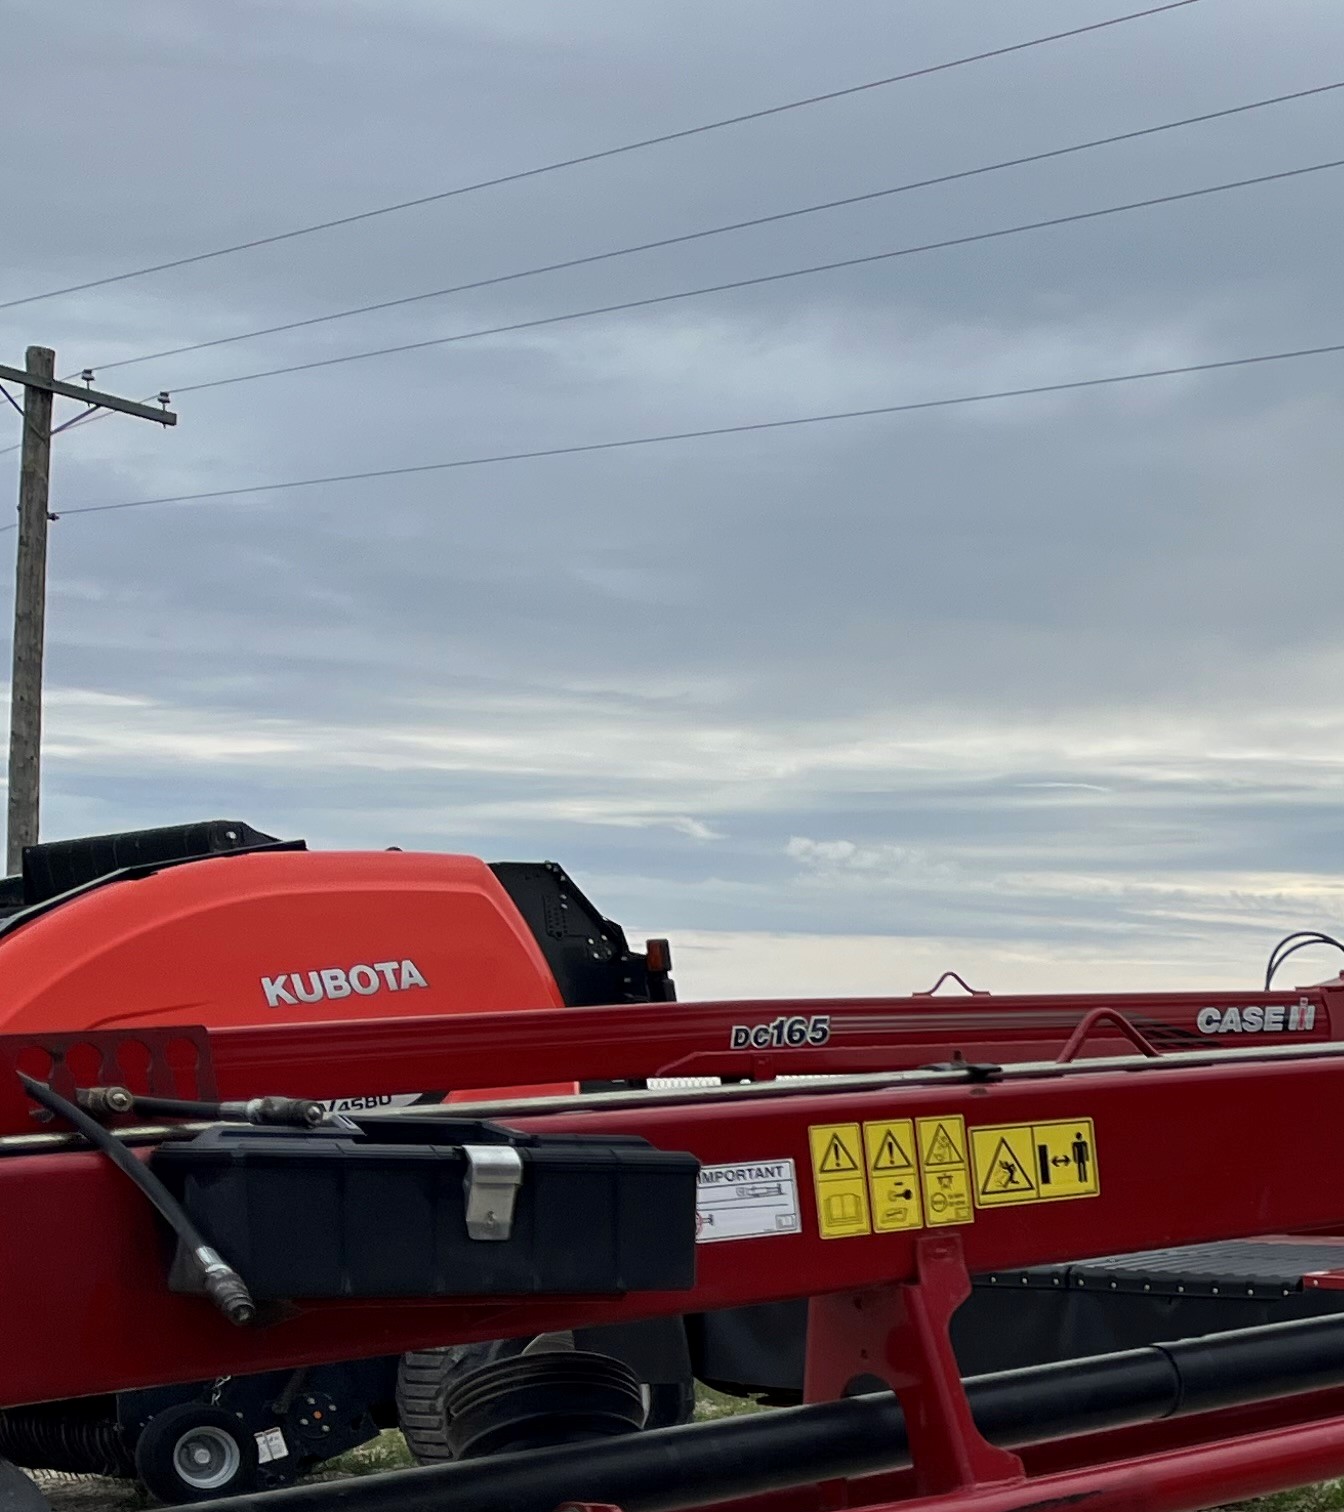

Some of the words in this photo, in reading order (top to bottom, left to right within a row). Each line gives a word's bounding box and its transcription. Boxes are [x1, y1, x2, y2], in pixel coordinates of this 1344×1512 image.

[260, 960, 428, 1007] KUBOTA
[730, 1015, 830, 1049] DC165
[1197, 1006, 1285, 1034] CASE
